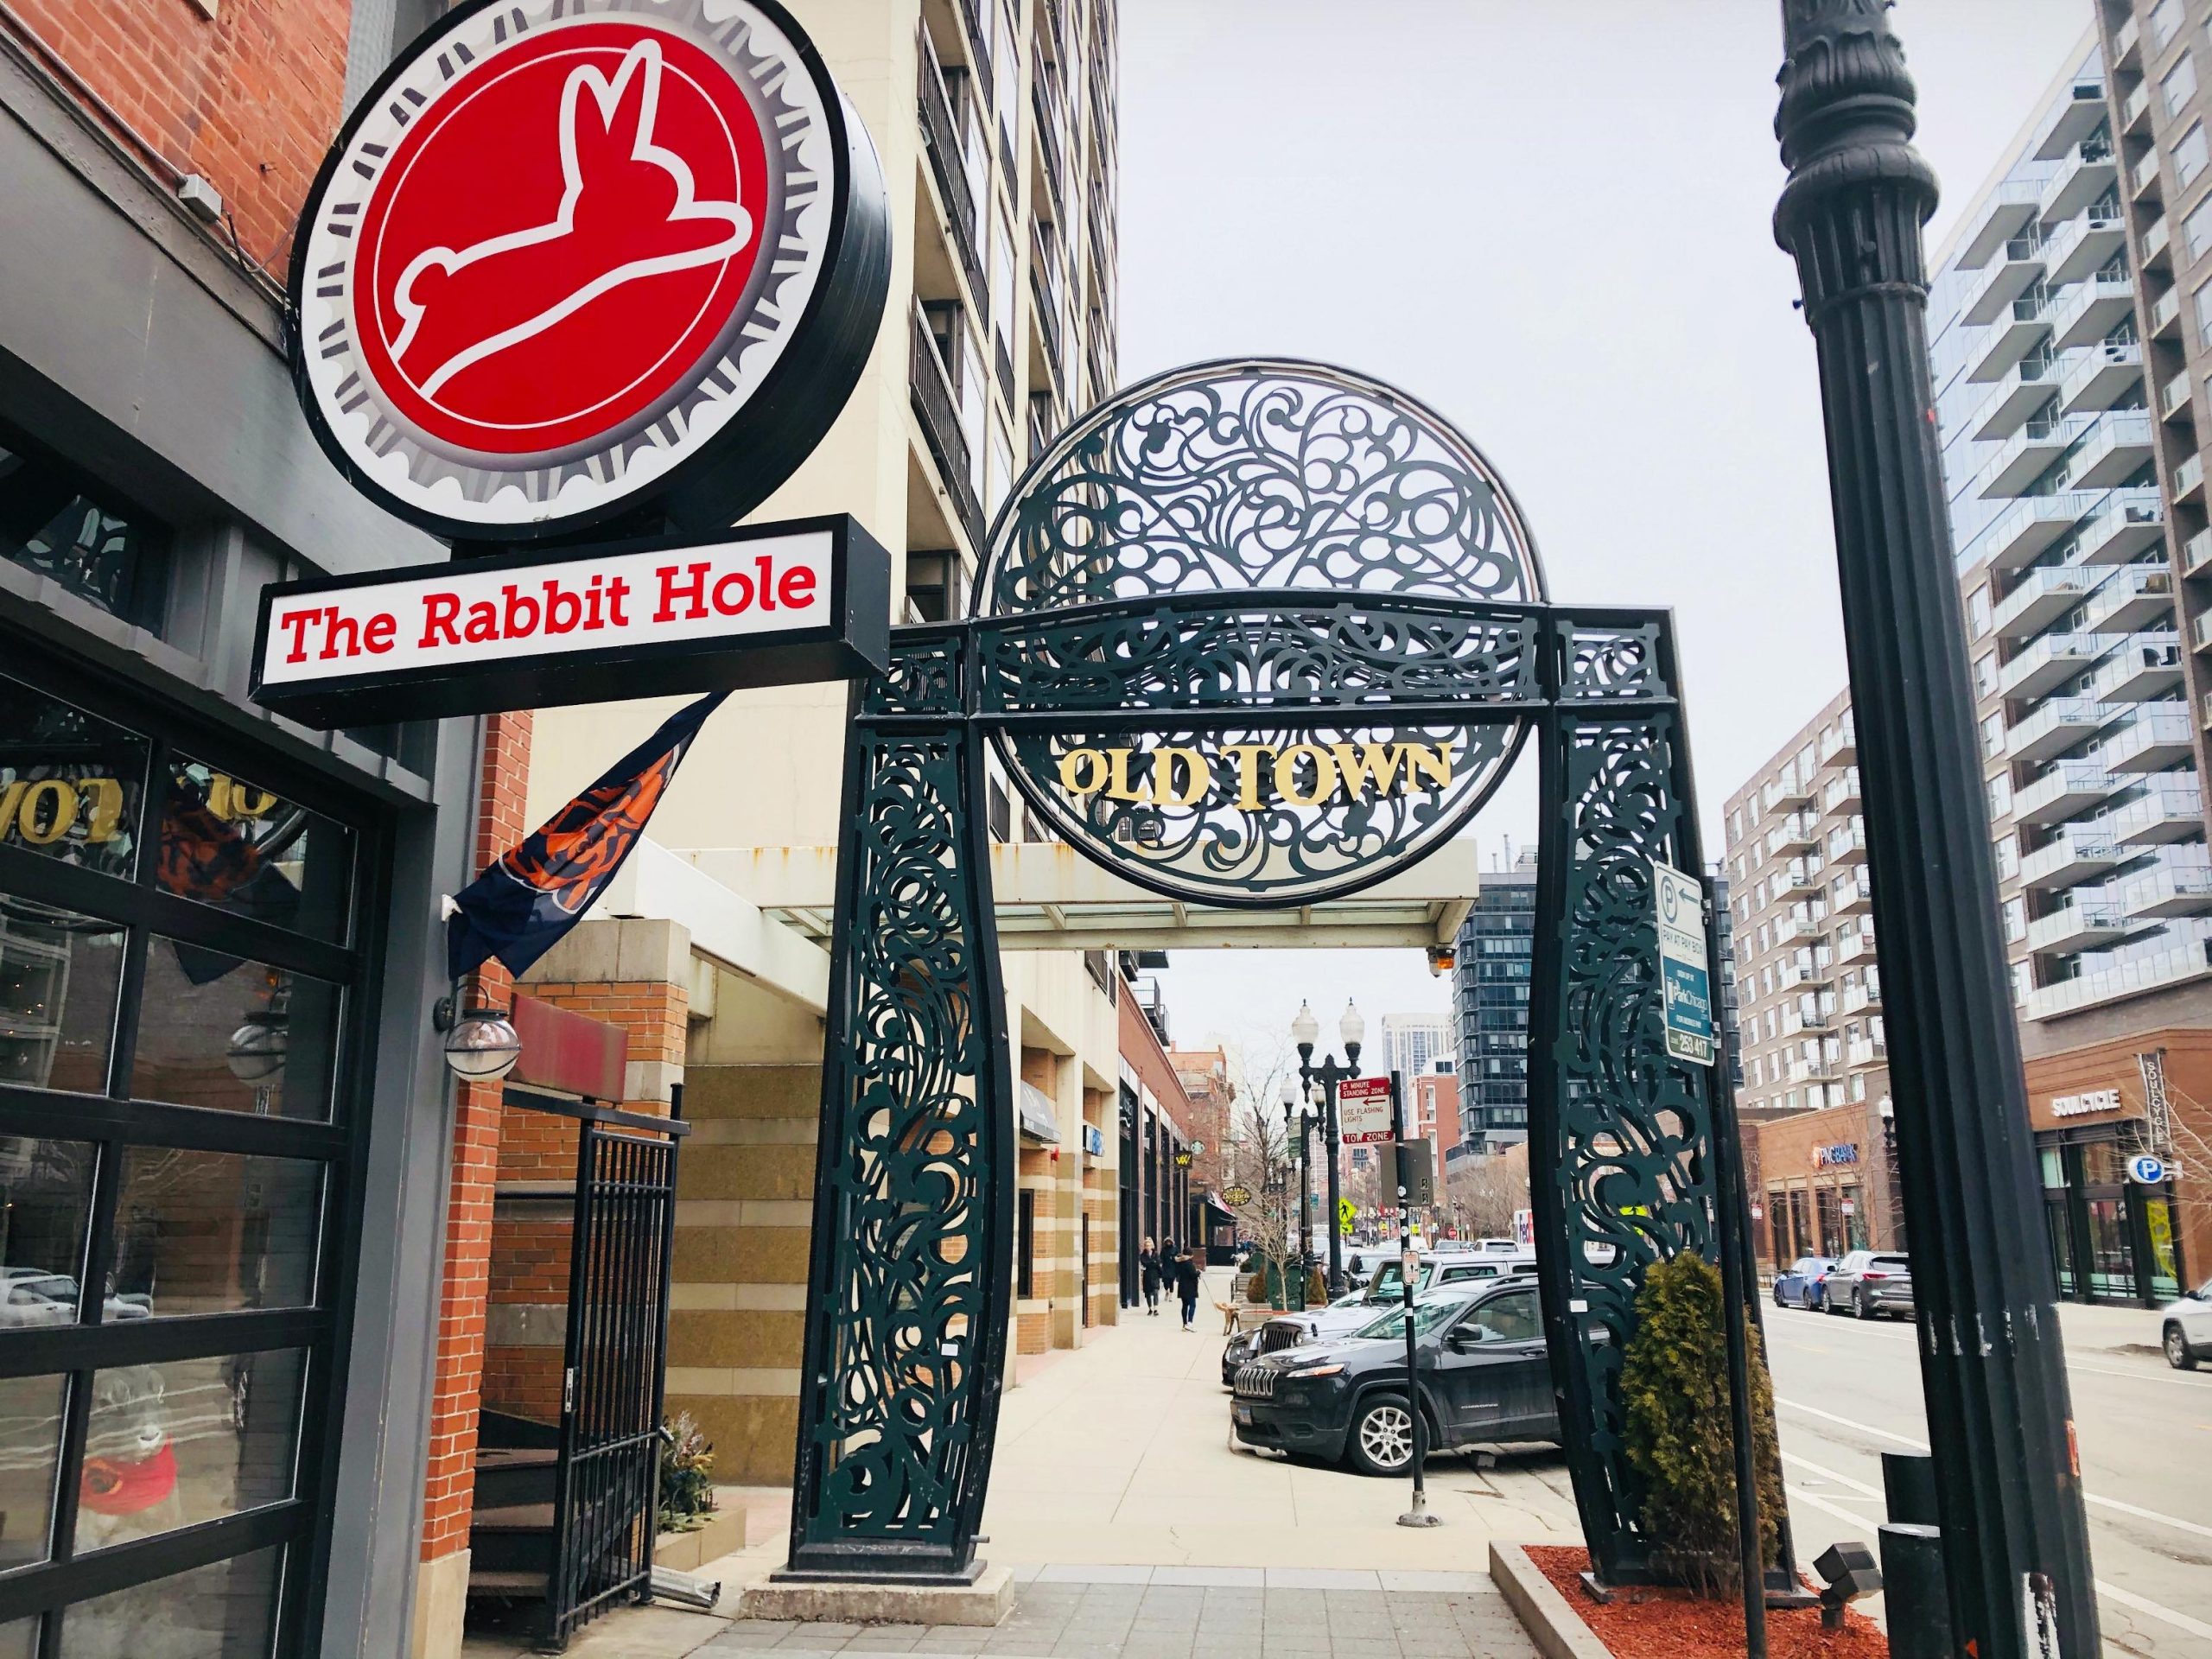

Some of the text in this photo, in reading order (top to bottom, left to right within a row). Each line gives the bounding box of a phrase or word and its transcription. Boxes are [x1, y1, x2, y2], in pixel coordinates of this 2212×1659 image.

[281, 556, 817, 664] The Rabbit Hole
[1058, 742, 1457, 810] OLD TOWN
[1343, 1089, 1369, 1097] STANDING
[2052, 1089, 2121, 1116] SOULCYCLE
[2146, 1061, 2164, 1144] SOULCYCLE
[1367, 1132, 1389, 1141] ZONE
[2142, 1160, 2158, 1179] P
